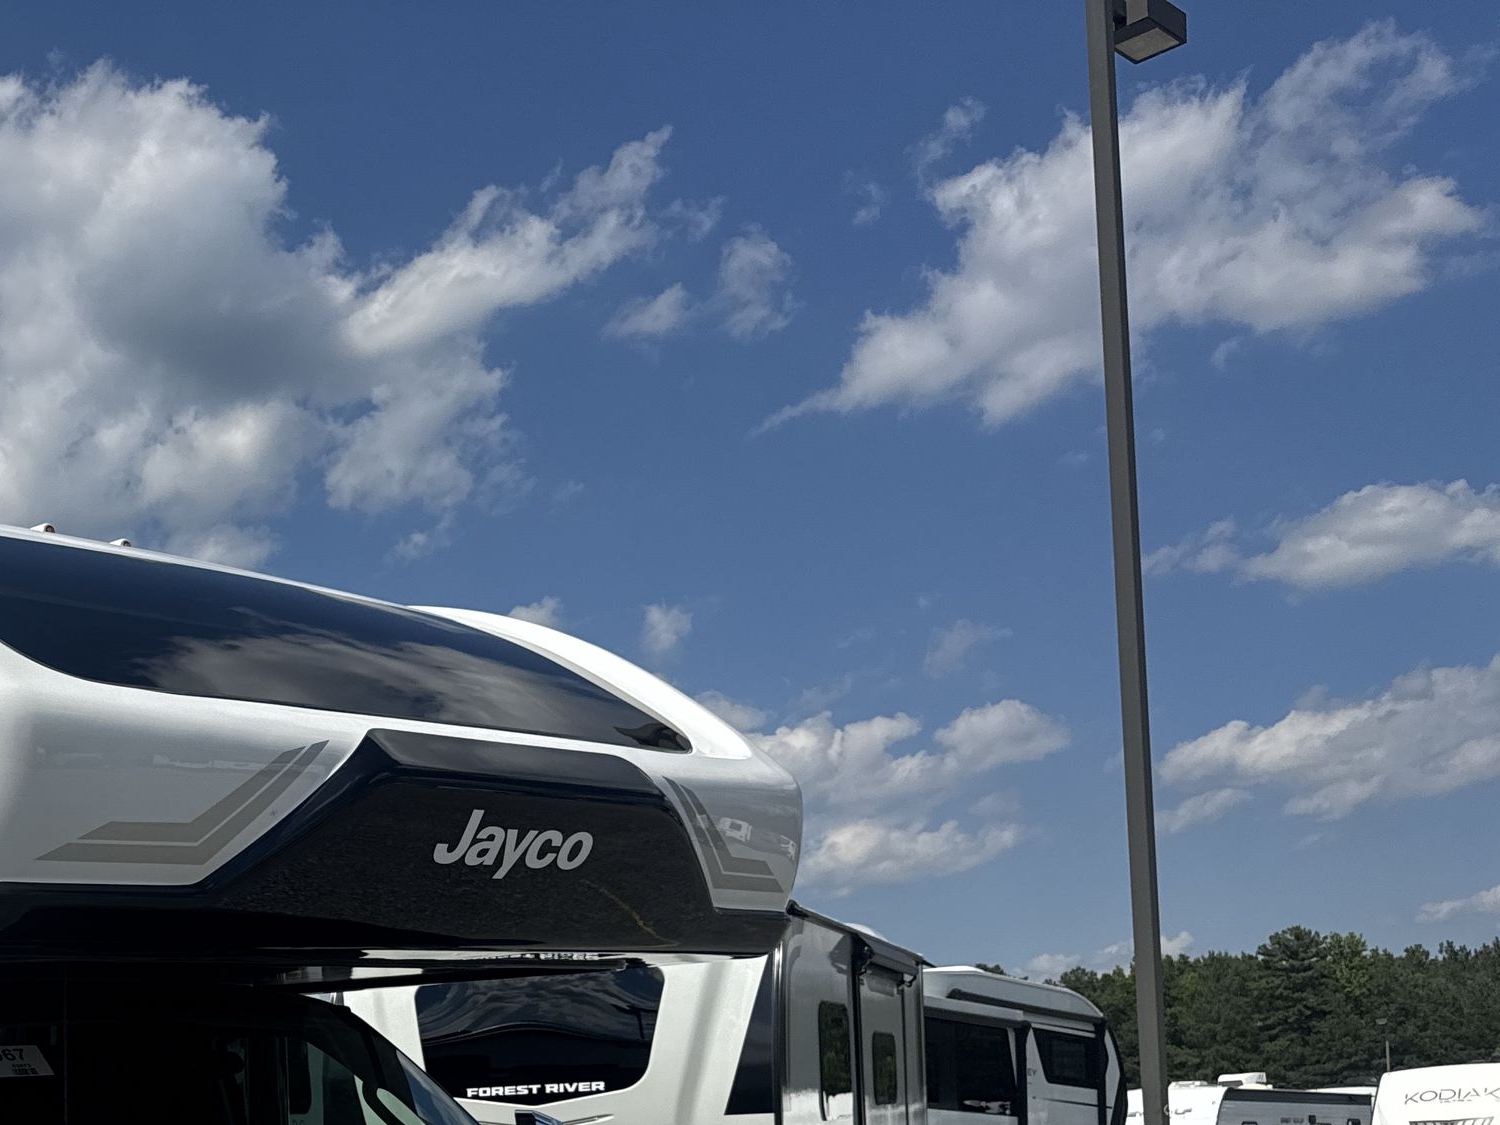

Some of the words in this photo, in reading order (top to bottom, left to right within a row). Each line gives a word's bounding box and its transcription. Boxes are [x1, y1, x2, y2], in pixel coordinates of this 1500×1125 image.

[433, 809, 594, 880] Jayco
[466, 1084, 541, 1098] FOREST
[544, 1081, 605, 1094] RIVER
[1404, 1088, 1500, 1105] KODIAK
